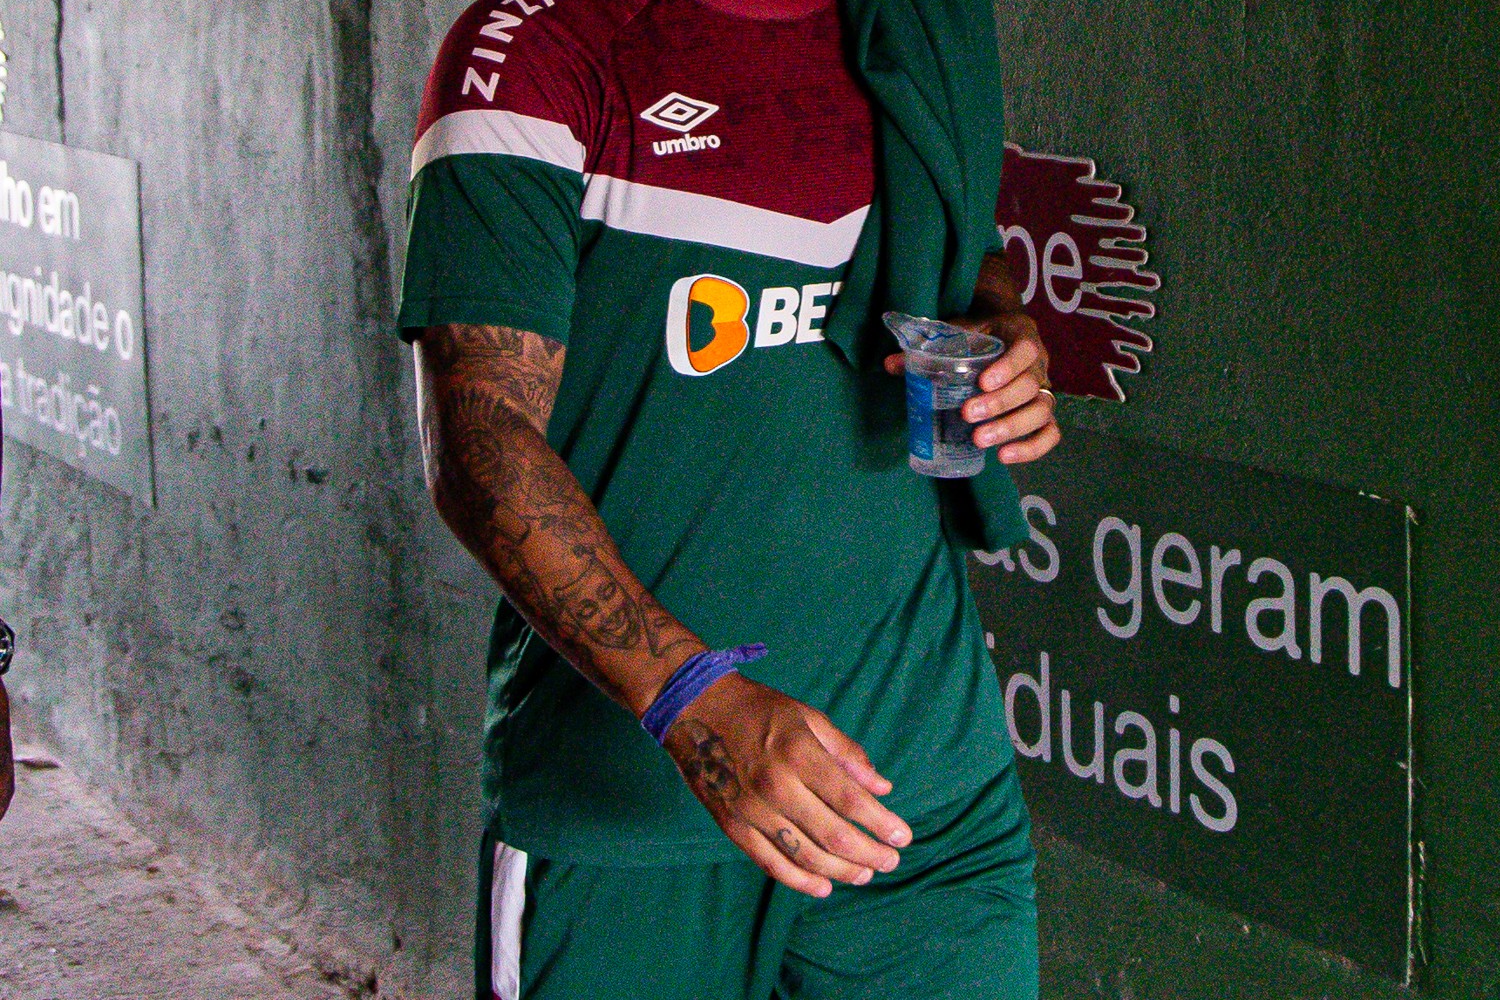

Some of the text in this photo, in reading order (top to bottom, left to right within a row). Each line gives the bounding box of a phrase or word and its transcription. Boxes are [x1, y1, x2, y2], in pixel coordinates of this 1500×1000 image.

[652, 130, 721, 156] umbro
[38, 185, 80, 240] em
[115, 310, 133, 361] o
[754, 281, 843, 348] BE
[17, 356, 121, 458] tradição
[1092, 516, 1401, 689] geram
[985, 631, 1239, 833] duais
